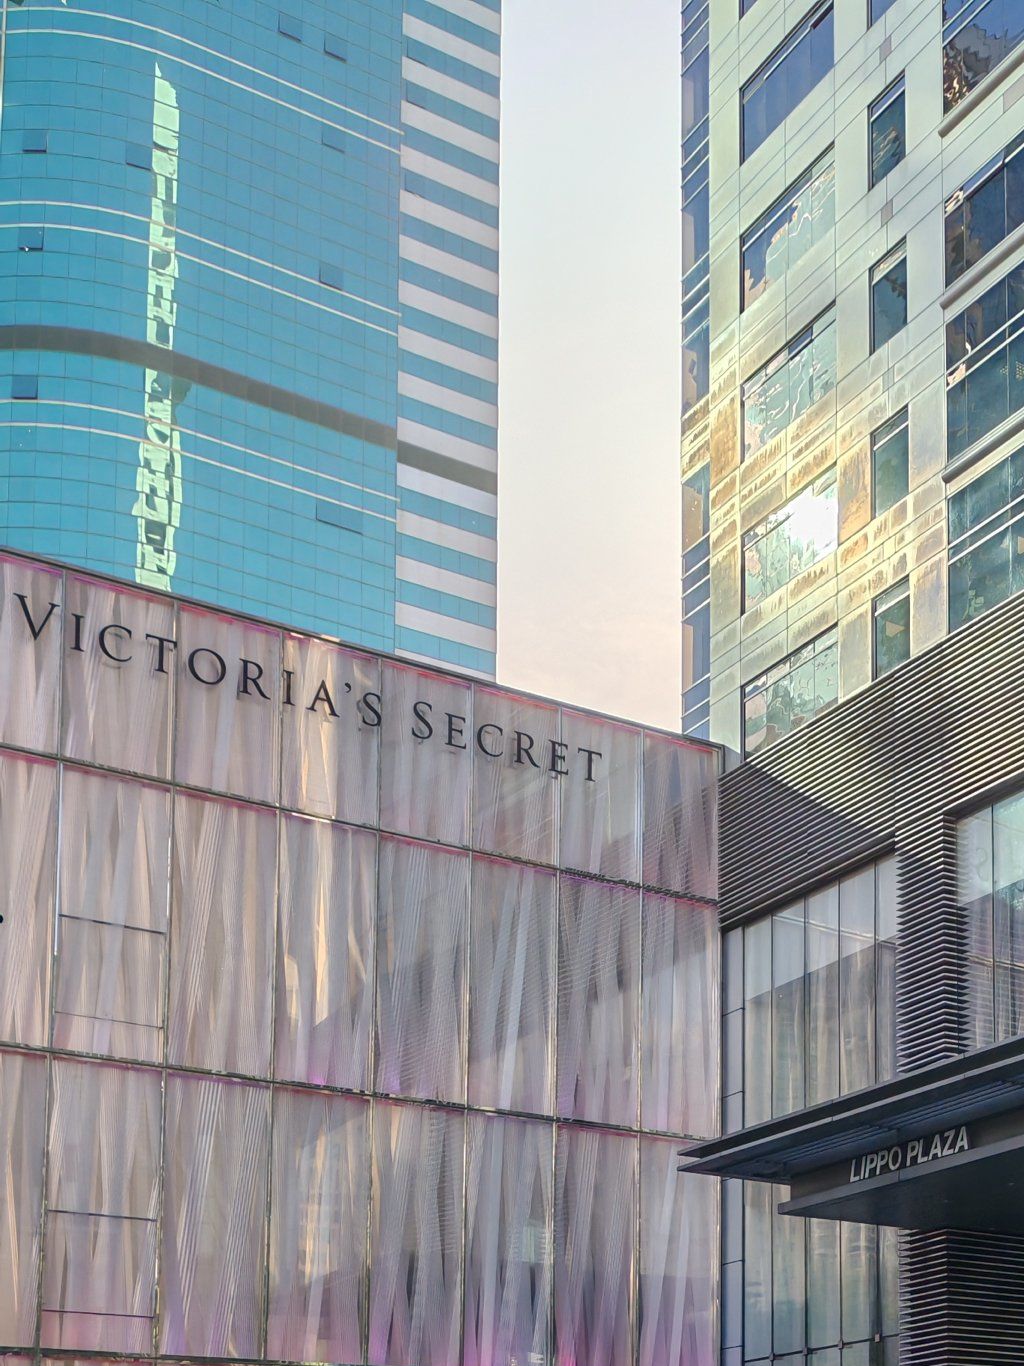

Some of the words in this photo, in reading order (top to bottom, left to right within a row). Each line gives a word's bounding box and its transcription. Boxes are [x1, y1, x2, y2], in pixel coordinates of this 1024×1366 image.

[13, 594, 383, 728] VICTORIA'S
[411, 701, 603, 783] SECRET
[849, 1146, 902, 1183] LIPPO
[905, 1126, 969, 1167] PLAZA
